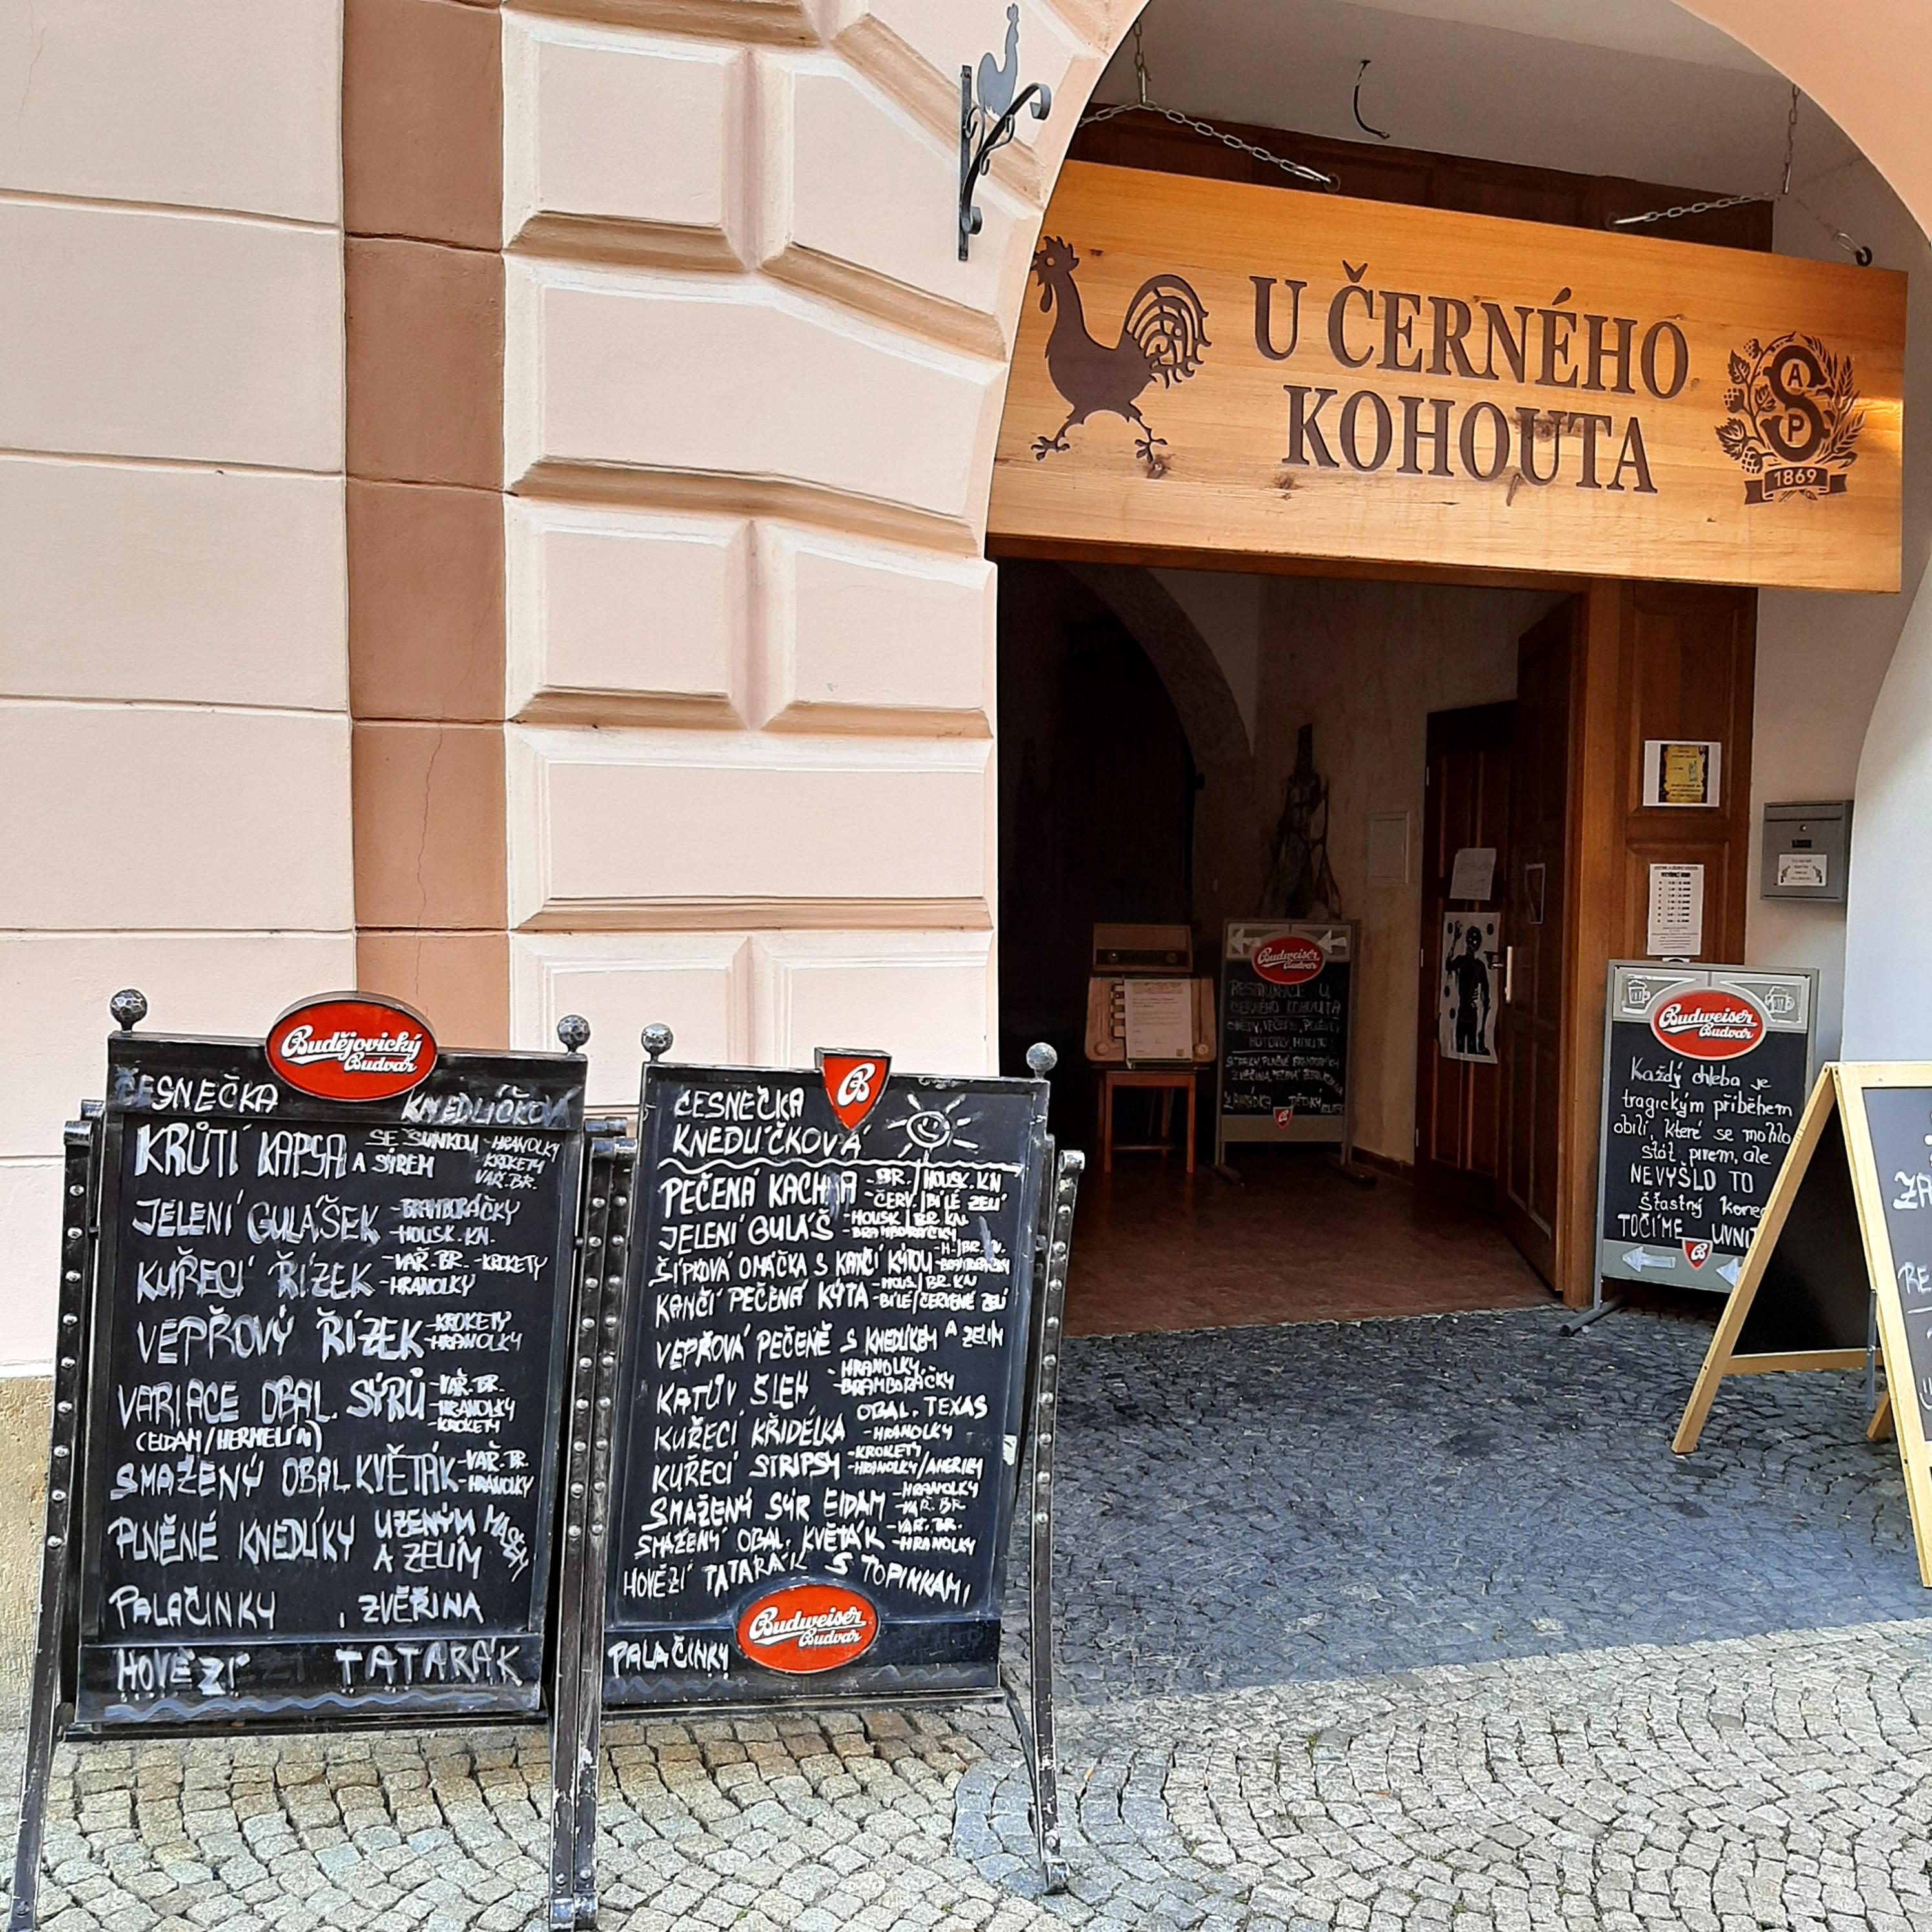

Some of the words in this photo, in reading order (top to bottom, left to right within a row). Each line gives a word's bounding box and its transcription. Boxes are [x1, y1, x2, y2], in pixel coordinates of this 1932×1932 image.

[1249, 276, 1307, 360] U
[1327, 260, 1689, 400] ČERNÉHO
[1282, 385, 1658, 493] KOHOUTA
[1774, 468, 1817, 488] 1869
[1257, 947, 1320, 966] Budweiser
[1658, 1003, 1756, 1031] Budweiser
[1699, 1024, 1753, 1040] Budvar
[281, 1025, 422, 1063] Budějovický
[344, 1051, 417, 1073] Budvar
[114, 1064, 278, 1113] ČESNEČKA
[837, 1063, 876, 1105] B
[1630, 1056, 1683, 1089] Každý
[1692, 1064, 1741, 1087] chleba
[1751, 1078, 1772, 1091] je
[1621, 1089, 1705, 1118] tragickým
[134, 1122, 252, 1178] KRŮTÍ
[258, 1130, 347, 1179] KAPSA
[365, 1129, 398, 1147] SE
[401, 1127, 479, 1155] ŠUNKOU
[672, 1122, 872, 1158] KNEDLÍČKOVÁ
[1665, 1118, 1703, 1140] které
[1713, 1129, 1734, 1142] se
[1742, 1122, 1792, 1144] mohlo
[352, 1152, 366, 1173] A
[371, 1147, 435, 1178] SÝREM
[1630, 1160, 1717, 1192] NEVYŠLO
[1729, 1171, 1754, 1194] TO
[1743, 1146, 1771, 1166] ale
[657, 1167, 760, 1218] PEČENÁ
[132, 1189, 244, 1237] JELENÍ
[247, 1195, 380, 1244] GULÁŠEK
[658, 1214, 745, 1254] JELENÍ
[748, 1209, 834, 1245] GULÁŠ
[1617, 1213, 1685, 1239] TOČÍME
[137, 1246, 254, 1304] KUŘECÍ
[267, 1251, 376, 1299] ŘÍZEK
[648, 1251, 734, 1287] ŠÍPKOVÁ
[739, 1249, 807, 1279] OMÁČKA
[814, 1252, 828, 1276] S
[889, 1242, 933, 1275] KÝTOU
[655, 1286, 723, 1328] KANČÍ
[728, 1279, 808, 1312] PEČENÁ
[818, 1277, 868, 1310] KÝTA
[137, 1304, 294, 1366] VEPŘOVÝ
[316, 1307, 424, 1363] ŘÍZEK
[656, 1323, 752, 1370] VEPŘOVÁ
[839, 1328, 858, 1353] S
[945, 1319, 958, 1337] A
[118, 1377, 239, 1430] VARIACE
[346, 1366, 426, 1423] SÝRŮ
[656, 1373, 737, 1416] KATŮV
[654, 1409, 745, 1452] KUŘECÍ
[924, 1395, 989, 1420] TEXAS
[110, 1453, 264, 1501] SMAŽENÝ
[356, 1441, 459, 1496] KVĚTÁK
[652, 1450, 739, 1494] KUŘECÍ
[749, 1451, 841, 1481] STRIPSY
[641, 1486, 753, 1531] SMAŽENÝ
[765, 1487, 810, 1521] SÝR
[824, 1486, 887, 1521] EIDAM
[108, 1509, 219, 1567] PLNĚNÉ
[239, 1506, 355, 1565] KNEDLÍKY
[375, 1501, 476, 1539] UZENÝM
[634, 1527, 728, 1560] SMAŽENÝ
[801, 1519, 886, 1552] KVĚTÁK
[373, 1544, 393, 1572] A
[402, 1536, 482, 1579] ZELÍM
[623, 1563, 694, 1599] HOVĚZÍ
[701, 1551, 808, 1598] TATARÁK
[825, 1551, 854, 1576] S
[861, 1553, 971, 1607] TOPINKAMI
[108, 1585, 276, 1630] PALAČINKY
[358, 1585, 484, 1624] ZVĚŘINA
[749, 1607, 867, 1644] Budweiser
[607, 1632, 730, 1679] PALAČINKY
[798, 1627, 862, 1647] Budvar
[336, 1638, 522, 1687] TATARÁK
